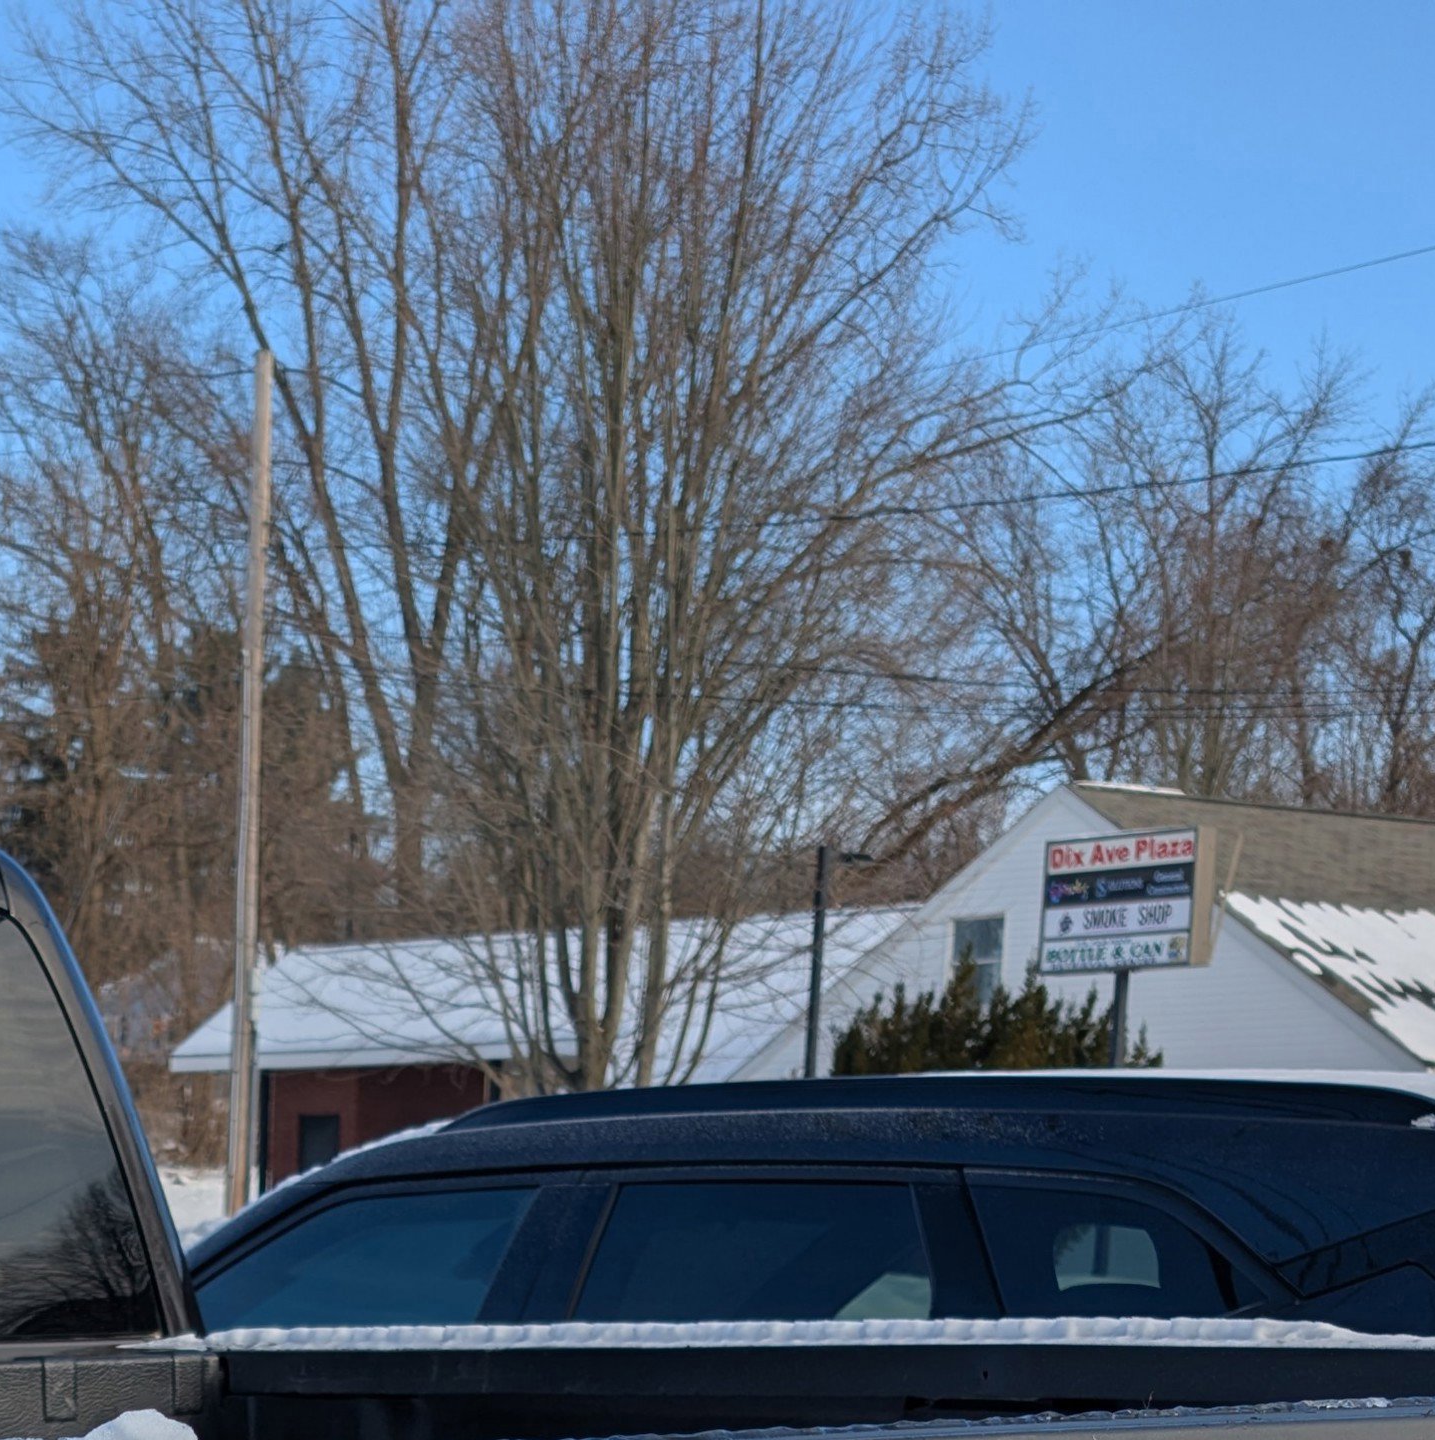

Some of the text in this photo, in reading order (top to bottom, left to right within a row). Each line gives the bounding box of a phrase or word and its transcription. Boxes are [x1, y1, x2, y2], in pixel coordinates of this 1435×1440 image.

[1050, 836, 1194, 870] Dix Ave Plaza
[1082, 903, 1173, 930] SMOKE SHOP
[1130, 940, 1162, 958] CAN
